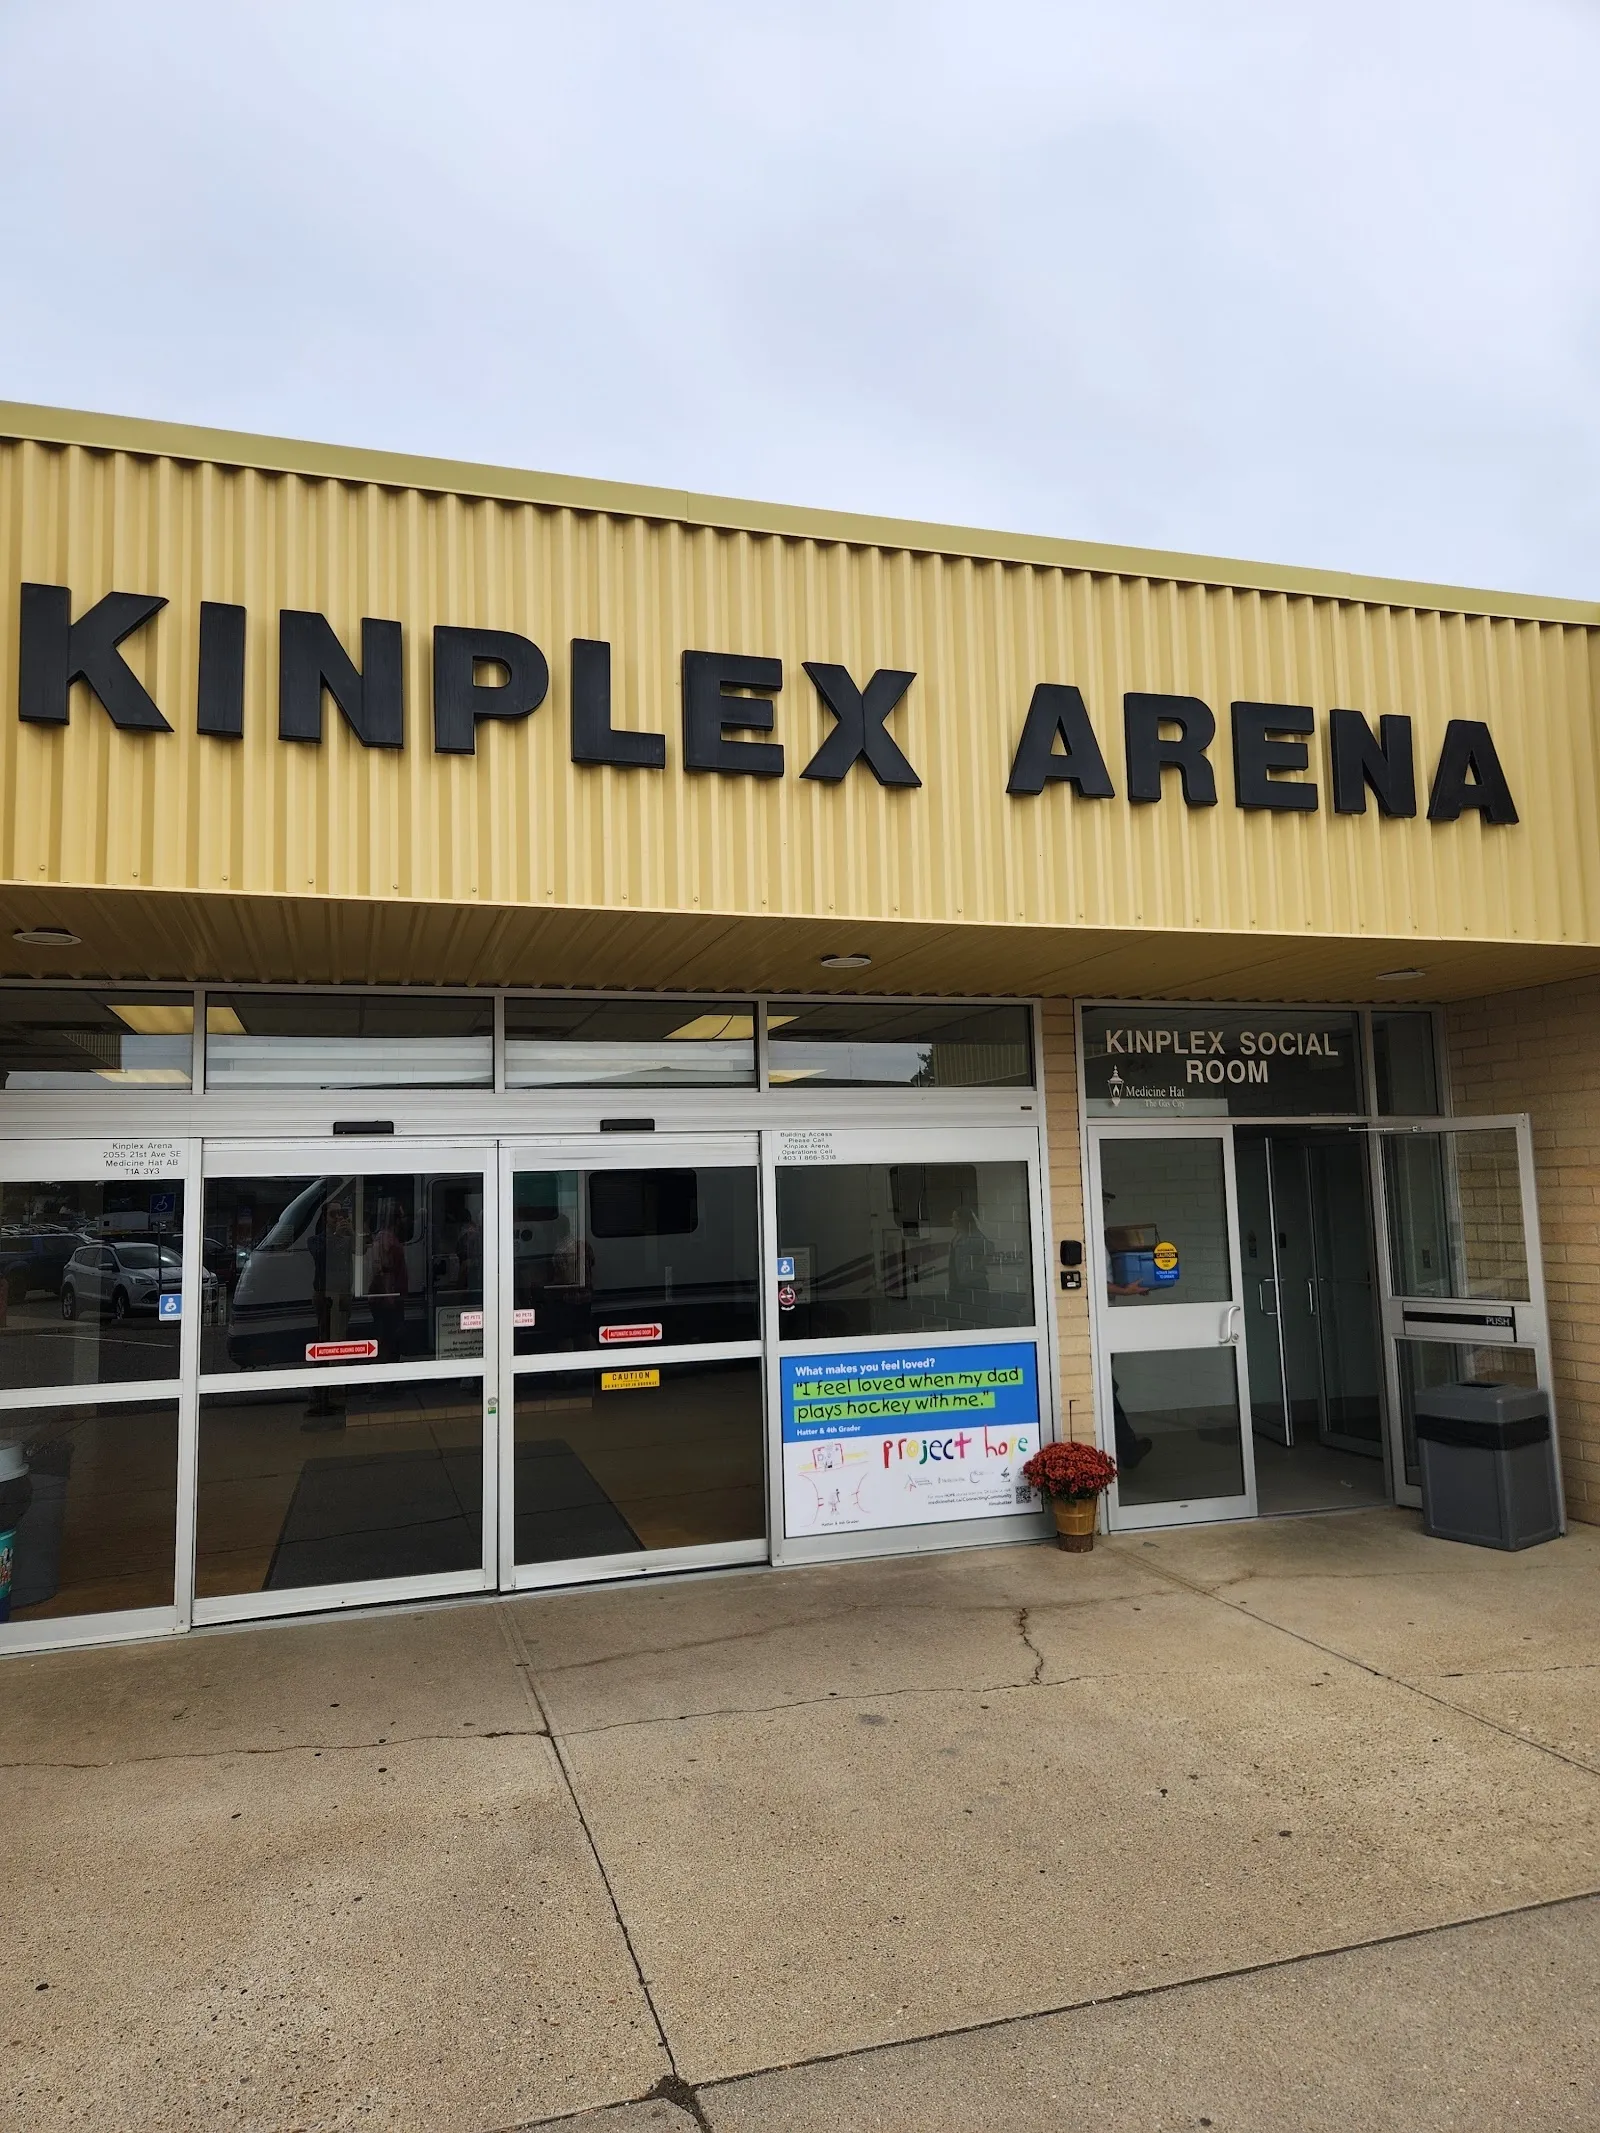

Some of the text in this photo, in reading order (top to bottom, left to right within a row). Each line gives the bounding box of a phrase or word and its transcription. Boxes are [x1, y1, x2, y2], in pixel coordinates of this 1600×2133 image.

[18, 582, 1519, 825] KINPLEX ARENA
[1105, 1029, 1339, 1057] KINPLEX SOCIAL
[1186, 1059, 1269, 1084] ROOM
[1126, 1086, 1185, 1098] Medicine Hat
[1144, 1099, 1185, 1110] The Gas City
[112, 1143, 144, 1151] Kinplex
[1486, 1316, 1510, 1326] PUSH
[612, 1371, 650, 1381] CAUTION
[795, 1358, 935, 1377] What makes you feel loved?
[817, 1378, 852, 1396] feel
[857, 1374, 905, 1392] loved
[909, 1372, 955, 1388] when
[958, 1371, 983, 1388] my
[987, 1366, 1019, 1382] dad
[798, 1401, 843, 1423] plays
[847, 1396, 911, 1415] hockey
[914, 1394, 950, 1410] with
[797, 1424, 861, 1436] Hatter & 4th Grader
[883, 1424, 1029, 1468] project hope
